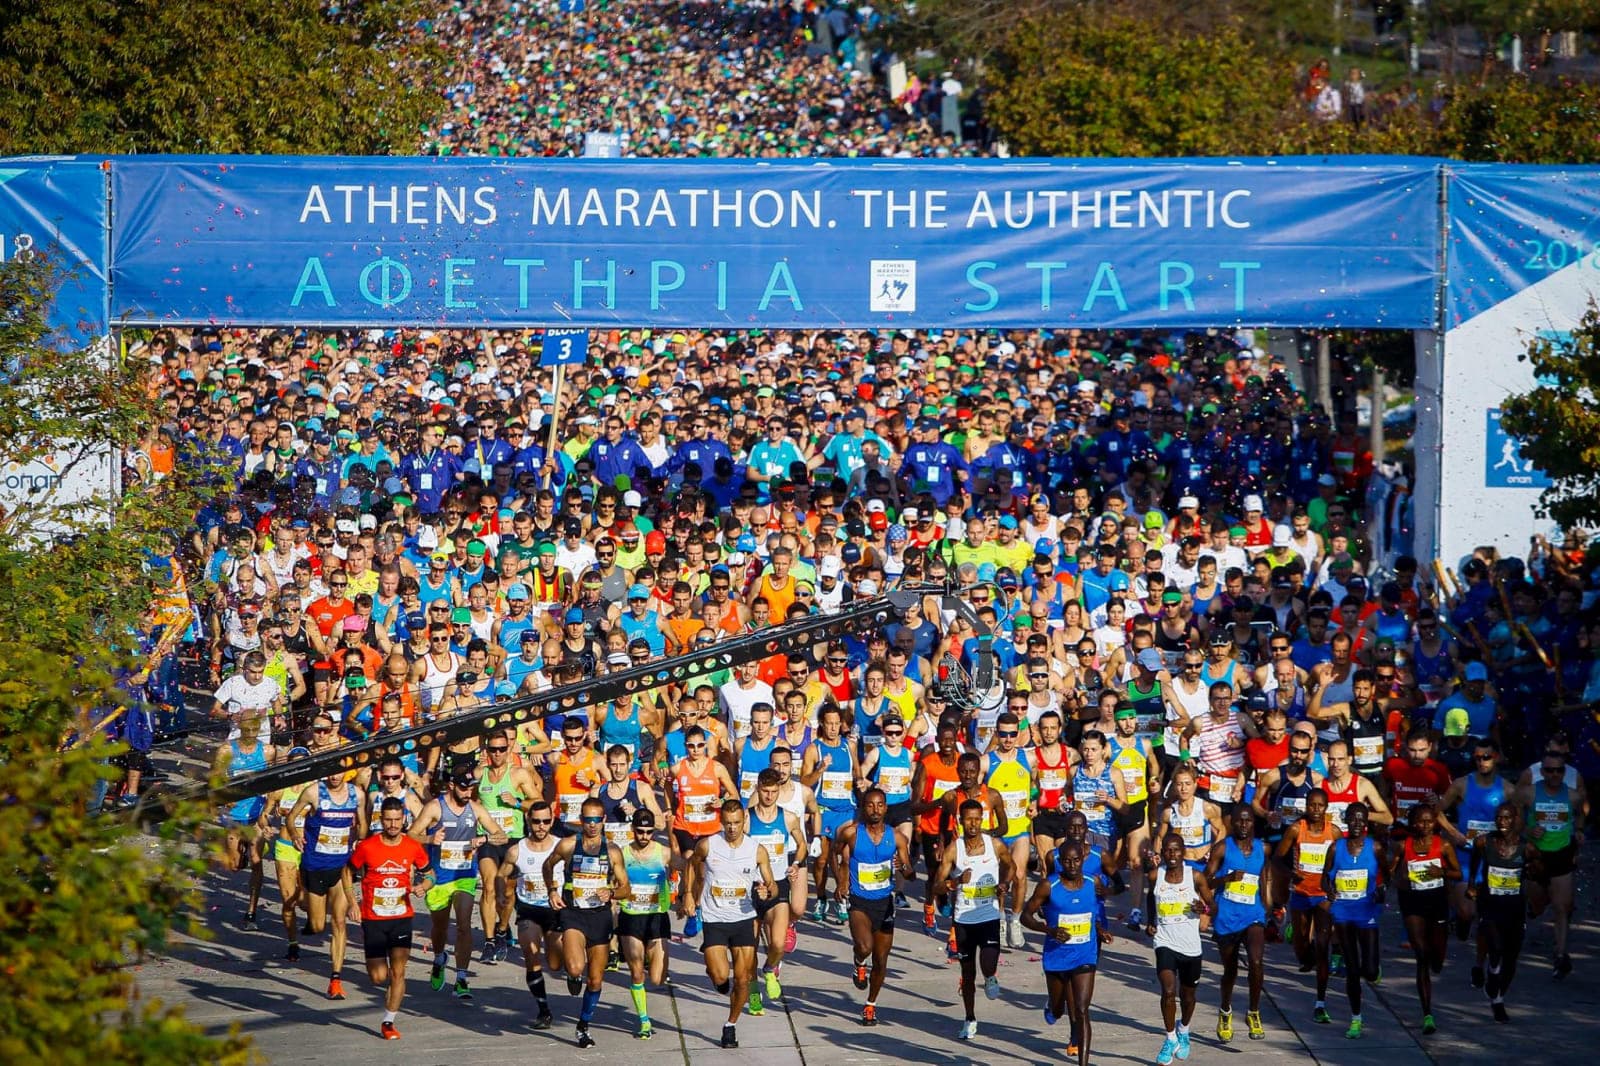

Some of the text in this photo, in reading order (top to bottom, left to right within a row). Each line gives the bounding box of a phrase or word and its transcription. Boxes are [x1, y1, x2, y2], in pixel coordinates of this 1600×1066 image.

[300, 184, 1251, 229] ATHENS MARATHON. THE AUTHENTIC
[290, 256, 803, 312] ΑΦΕΤΗΡΙΑ
[964, 260, 1261, 313] START
[558, 338, 572, 360] 3
[1344, 880, 1358, 888] 103
[635, 894, 650, 902] 205
[1072, 925, 1081, 933] 11
